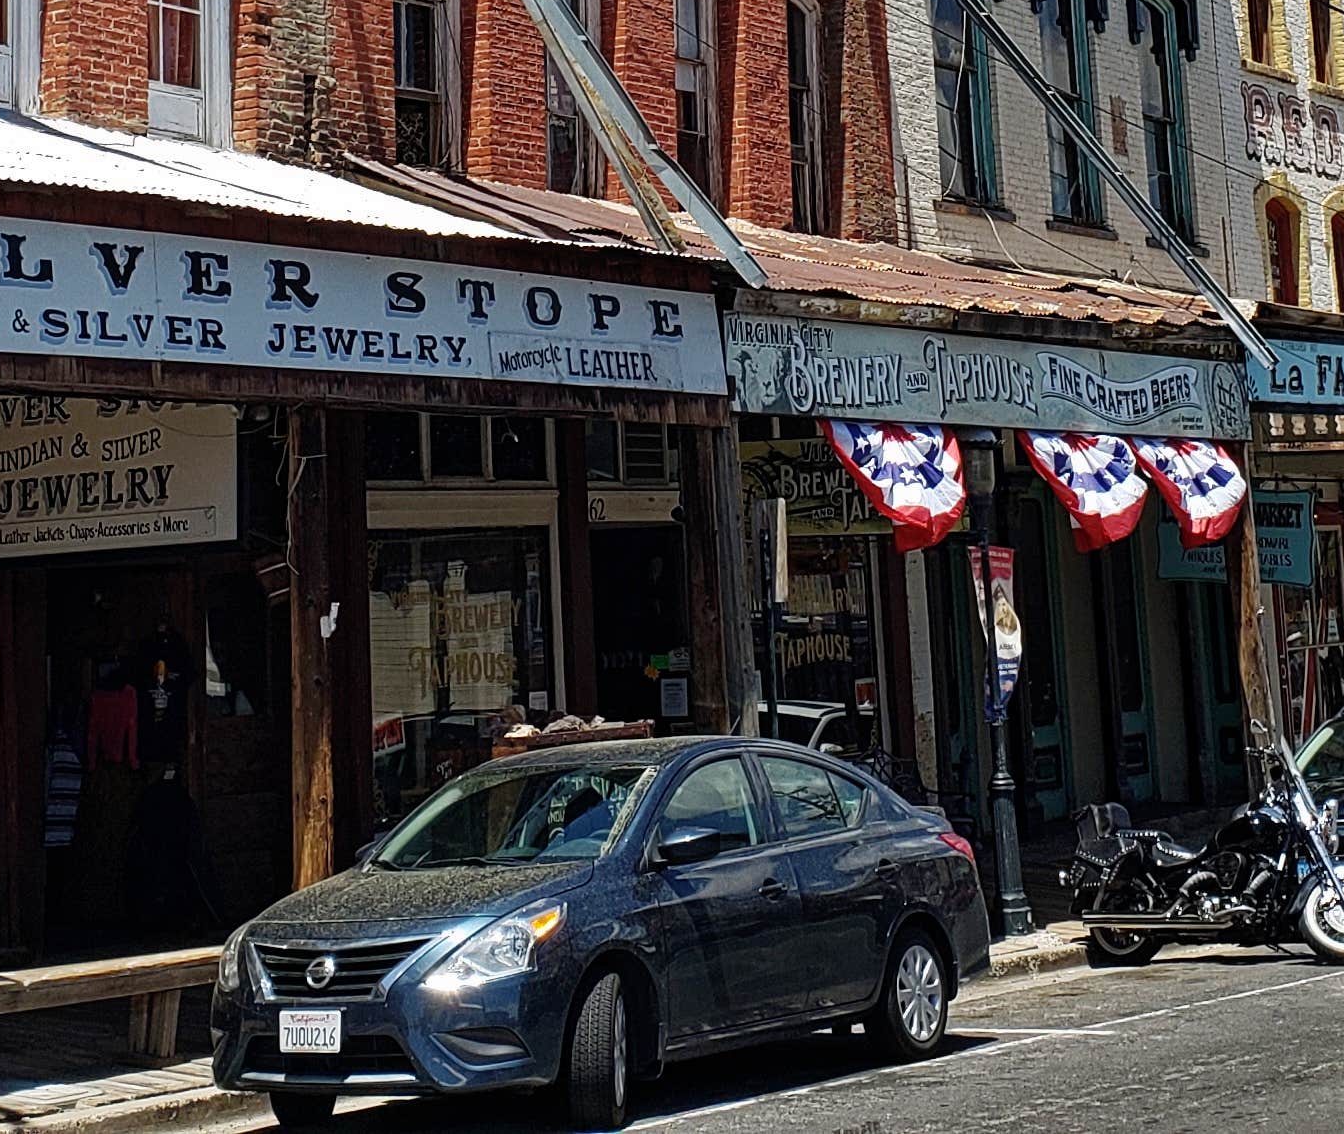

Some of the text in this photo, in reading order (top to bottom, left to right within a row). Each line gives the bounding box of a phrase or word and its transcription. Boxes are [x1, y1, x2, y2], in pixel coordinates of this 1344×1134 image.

[1241, 81, 1344, 181] RED
[386, 271, 684, 338] STOPE
[11, 308, 31, 334] &
[41, 308, 226, 350] SILVER
[499, 345, 562, 373] Motorcycle
[566, 347, 657, 382] LEATHER
[729, 318, 834, 351] VIRGINIA CITY
[786, 334, 1040, 418] BREWERY AND TAPHOUSE
[1048, 355, 1192, 418] FINE CRAFTED BEERS
[1269, 363, 1304, 395] La
[0, 428, 162, 473] INDIAN & SILVER
[0, 529, 30, 545] Leather
[33, 526, 65, 543] Jackets
[69, 523, 95, 541] Chaps
[97, 521, 150, 537] Accessories
[153, 520, 161, 532] &
[162, 516, 189, 532] More
[589, 498, 606, 521] 62
[812, 507, 835, 519] AND
[774, 631, 853, 682] TAPHOUSE
